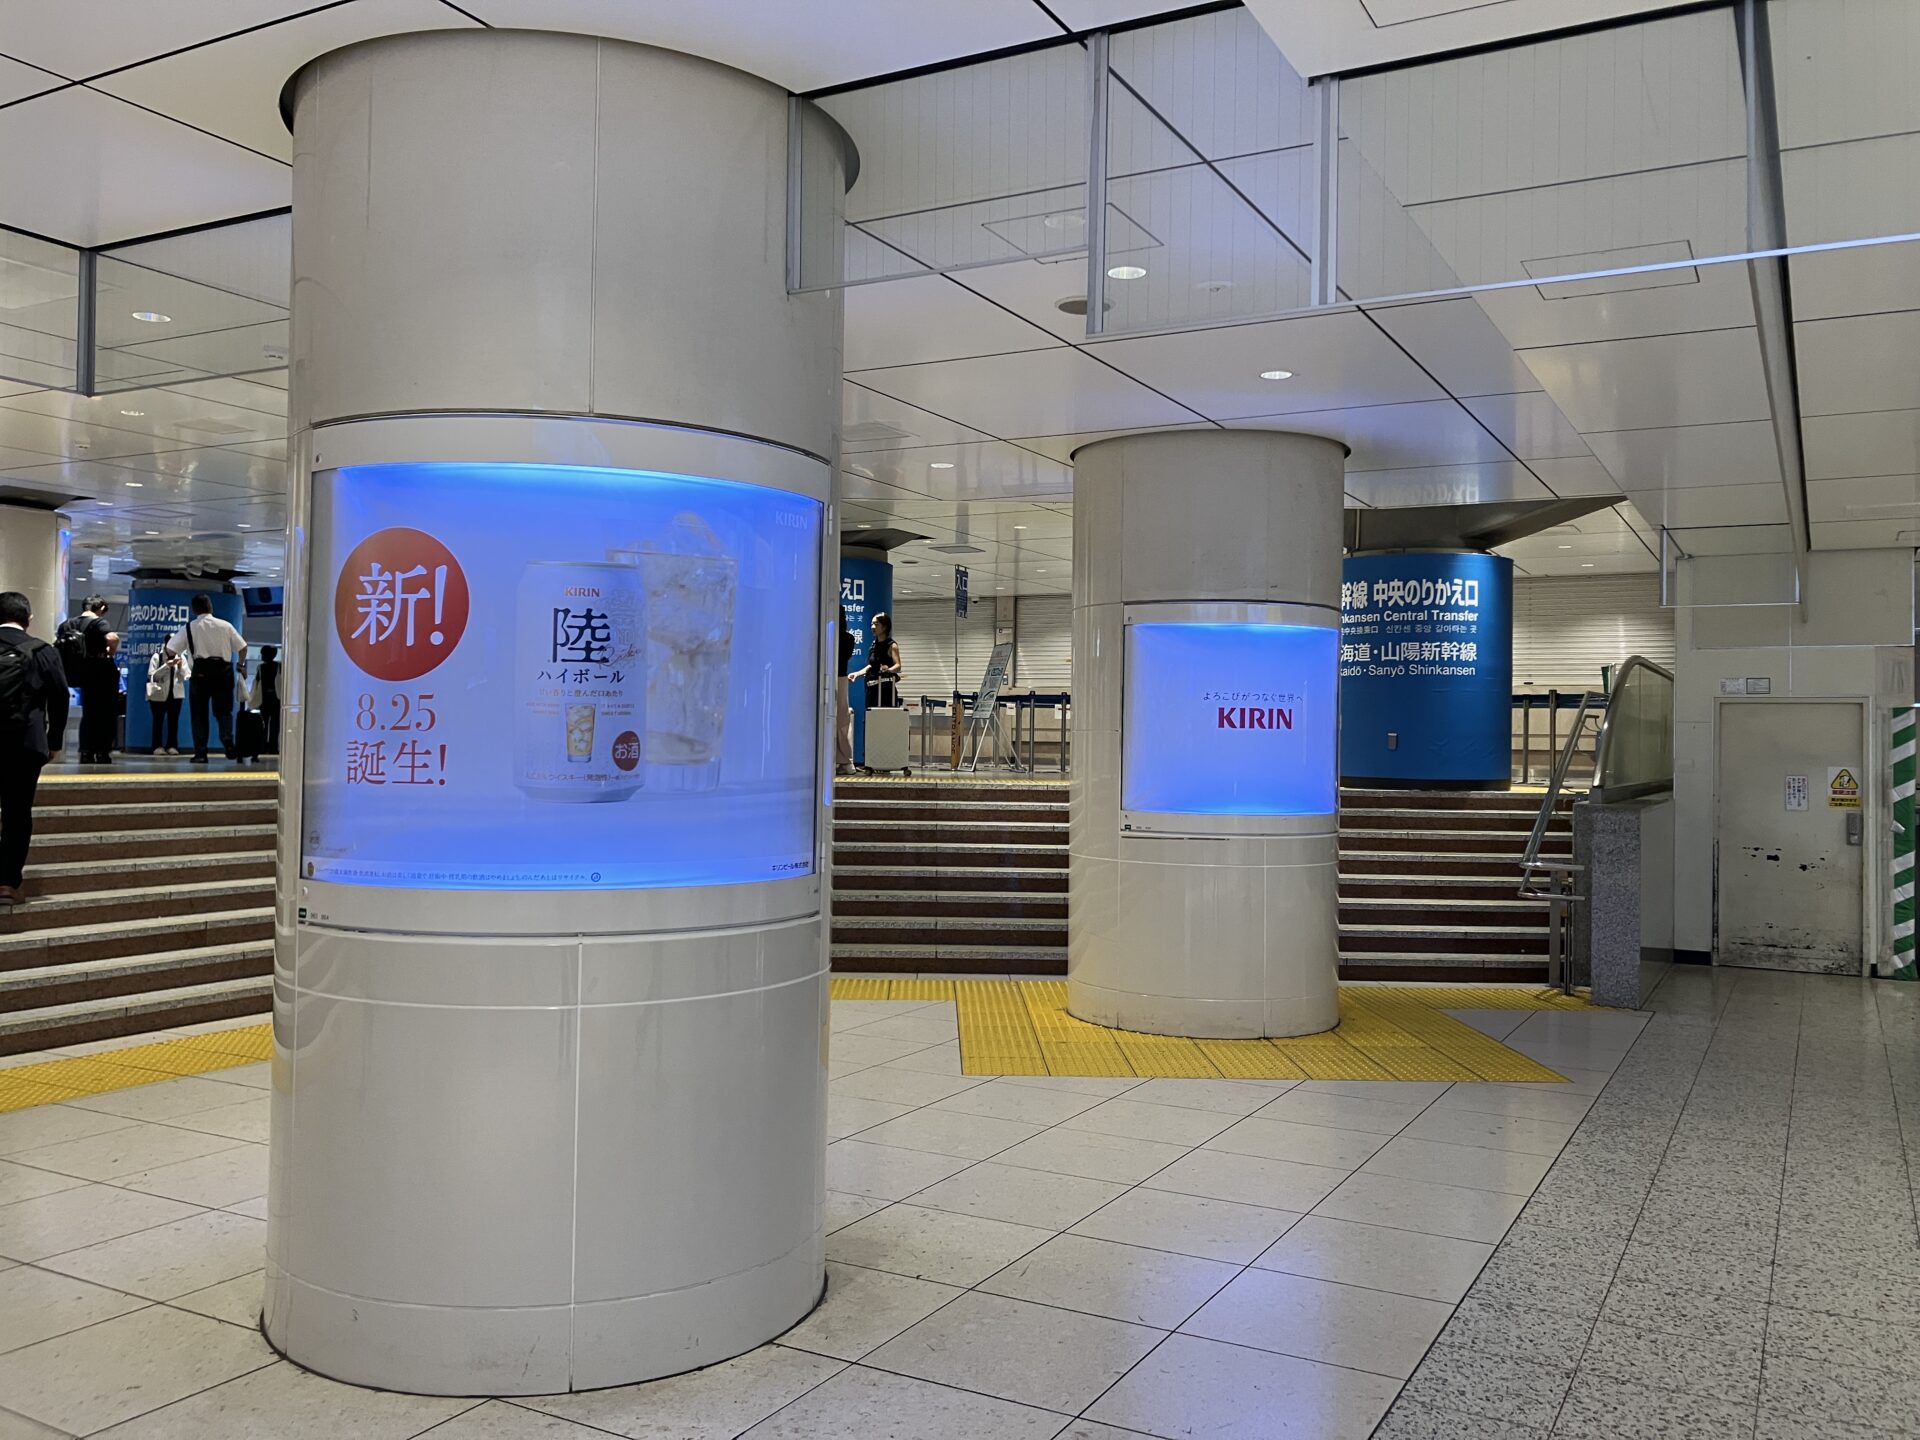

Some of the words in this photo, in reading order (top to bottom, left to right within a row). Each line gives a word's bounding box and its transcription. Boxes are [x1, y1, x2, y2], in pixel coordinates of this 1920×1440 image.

[775, 511, 808, 529] KIRIN
[565, 587, 600, 597] KIRIN
[840, 578, 864, 601] え口
[1373, 578, 1479, 608] 中央のりかえ口
[351, 562, 448, 647] 新!
[1383, 610, 1428, 621] Central
[1432, 609, 1479, 622] Transfer
[552, 607, 611, 663] 陸
[537, 668, 624, 684] ハイボール
[1408, 664, 1475, 676] Shinkansen
[1203, 692, 1304, 703] よろこびがつなぐ世界へ
[356, 693, 436, 731] 8.25
[1218, 707, 1292, 729] KIRIN
[614, 742, 639, 759] お酒
[346, 739, 447, 786] 誕生!
